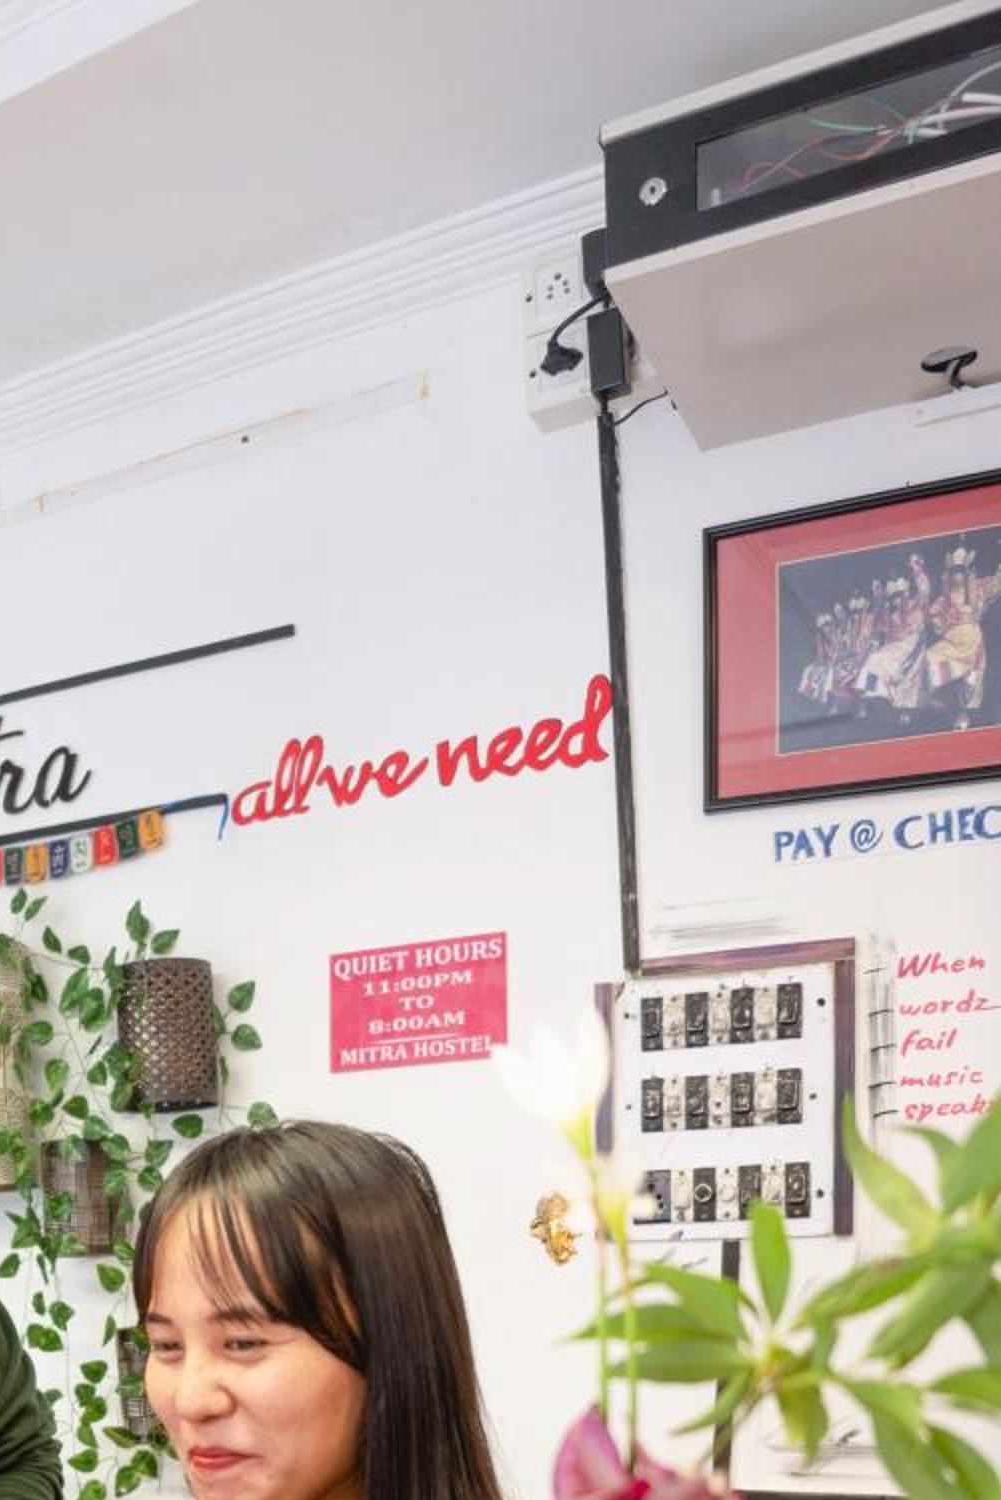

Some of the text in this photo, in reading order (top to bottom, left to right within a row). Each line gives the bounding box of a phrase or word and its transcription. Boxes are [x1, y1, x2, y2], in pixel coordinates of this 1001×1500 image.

[231, 734, 324, 826] all
[437, 673, 614, 787] need
[773, 824, 840, 863] PAY
[850, 819, 883, 853] @
[334, 938, 503, 981] QUIET HOURS
[897, 951, 986, 978] When
[363, 969, 473, 996] 11:00PM
[399, 994, 435, 1011] TO
[368, 1011, 466, 1035] 8:00AM
[340, 1035, 495, 1066] MITRA HOSTEL
[901, 1027, 958, 1057] fail
[900, 1066, 984, 1088] music
